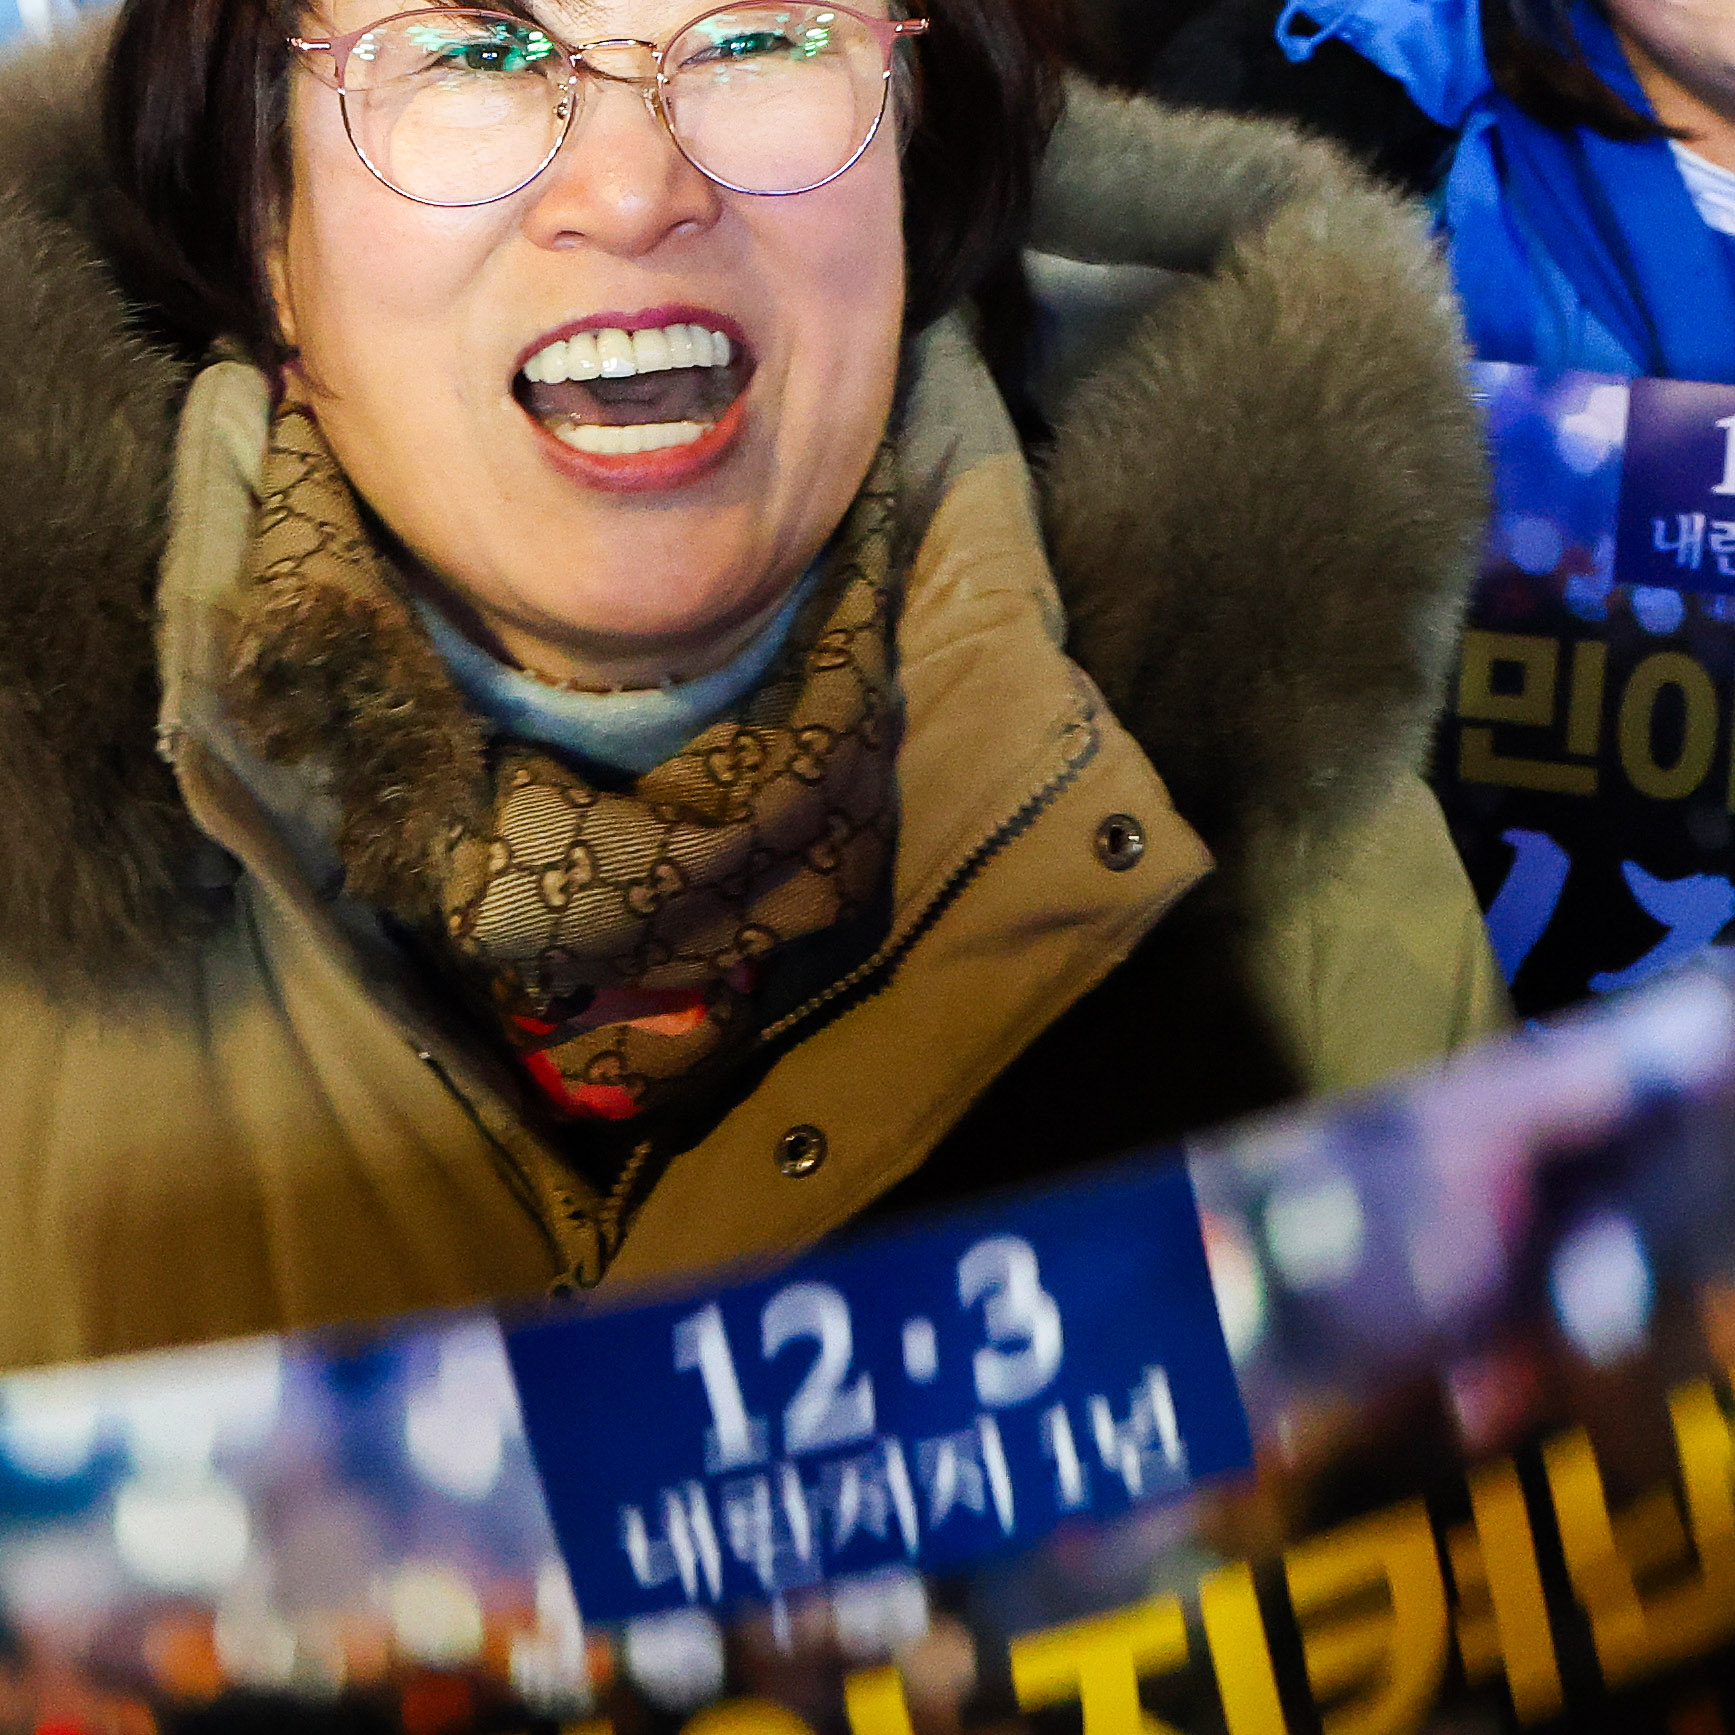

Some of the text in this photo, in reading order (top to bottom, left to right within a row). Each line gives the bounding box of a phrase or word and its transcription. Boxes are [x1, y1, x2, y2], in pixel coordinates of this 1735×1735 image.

[672, 1232, 1061, 1475] 12·3
[620, 1363, 1191, 1603] 내란저지 1년
